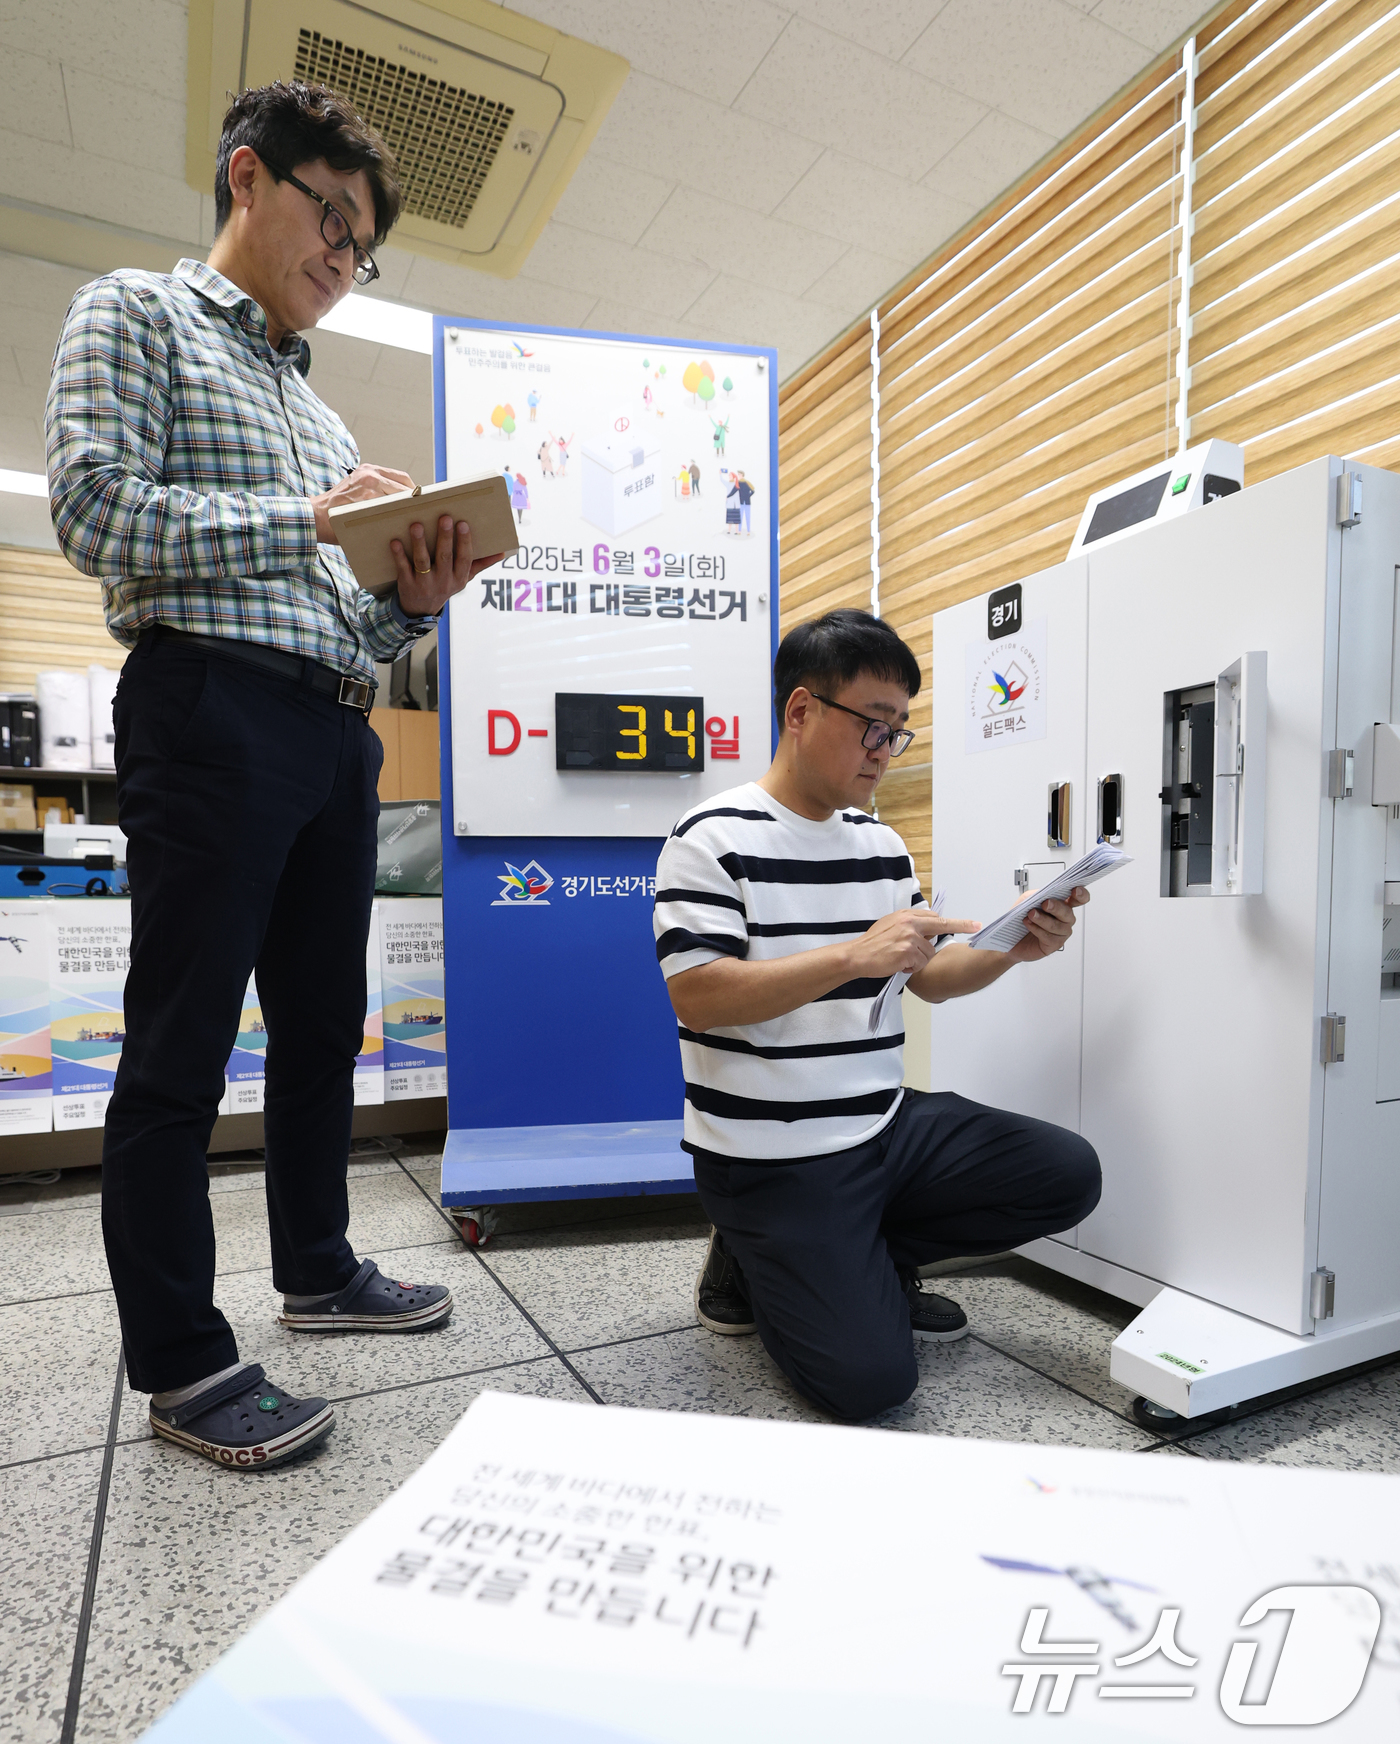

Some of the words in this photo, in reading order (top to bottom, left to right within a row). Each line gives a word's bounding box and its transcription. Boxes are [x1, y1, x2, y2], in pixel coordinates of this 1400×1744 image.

[398, 43, 438, 65] SAMSUNG
[455, 346, 487, 357] 투표하는
[489, 349, 513, 360] 발걸음
[468, 357, 508, 370] 민주주의를
[510, 361, 526, 371] 위한
[527, 363, 551, 373] 큰걸음
[623, 473, 655, 498] 투표함
[592, 543, 635, 576] 6월
[643, 546, 726, 580] 3일(화)
[480, 578, 577, 614] 제21대
[589, 583, 747, 622] 대통령선거
[991, 598, 1018, 628] 경기
[971, 671, 982, 717] NATIONAL
[984, 642, 1017, 665] ELECTION
[1020, 646, 1040, 701] COMMISSION
[615, 705, 696, 760] 34
[705, 716, 740, 759] 일
[982, 715, 1026, 739] 쉴드팩스
[82, 926, 112, 934] 바다에서
[405, 922, 428, 930] 바다에서
[58, 947, 112, 959] 대한민국을
[386, 940, 428, 952] 대한민국을
[59, 961, 91, 973] 물결을
[387, 953, 412, 964] 물결을
[200, 1442, 267, 1466] crocs
[509, 1467, 565, 1492] 세계
[569, 1473, 687, 1510] 바다에서
[694, 1490, 783, 1526] 전하는
[450, 1485, 540, 1518] 당신의
[542, 1499, 634, 1533] 소중한
[418, 1512, 657, 1576] 대한민국을
[671, 1550, 780, 1599] 위한
[374, 1547, 530, 1605] 물결을
[545, 1574, 767, 1650] 만듭니다
